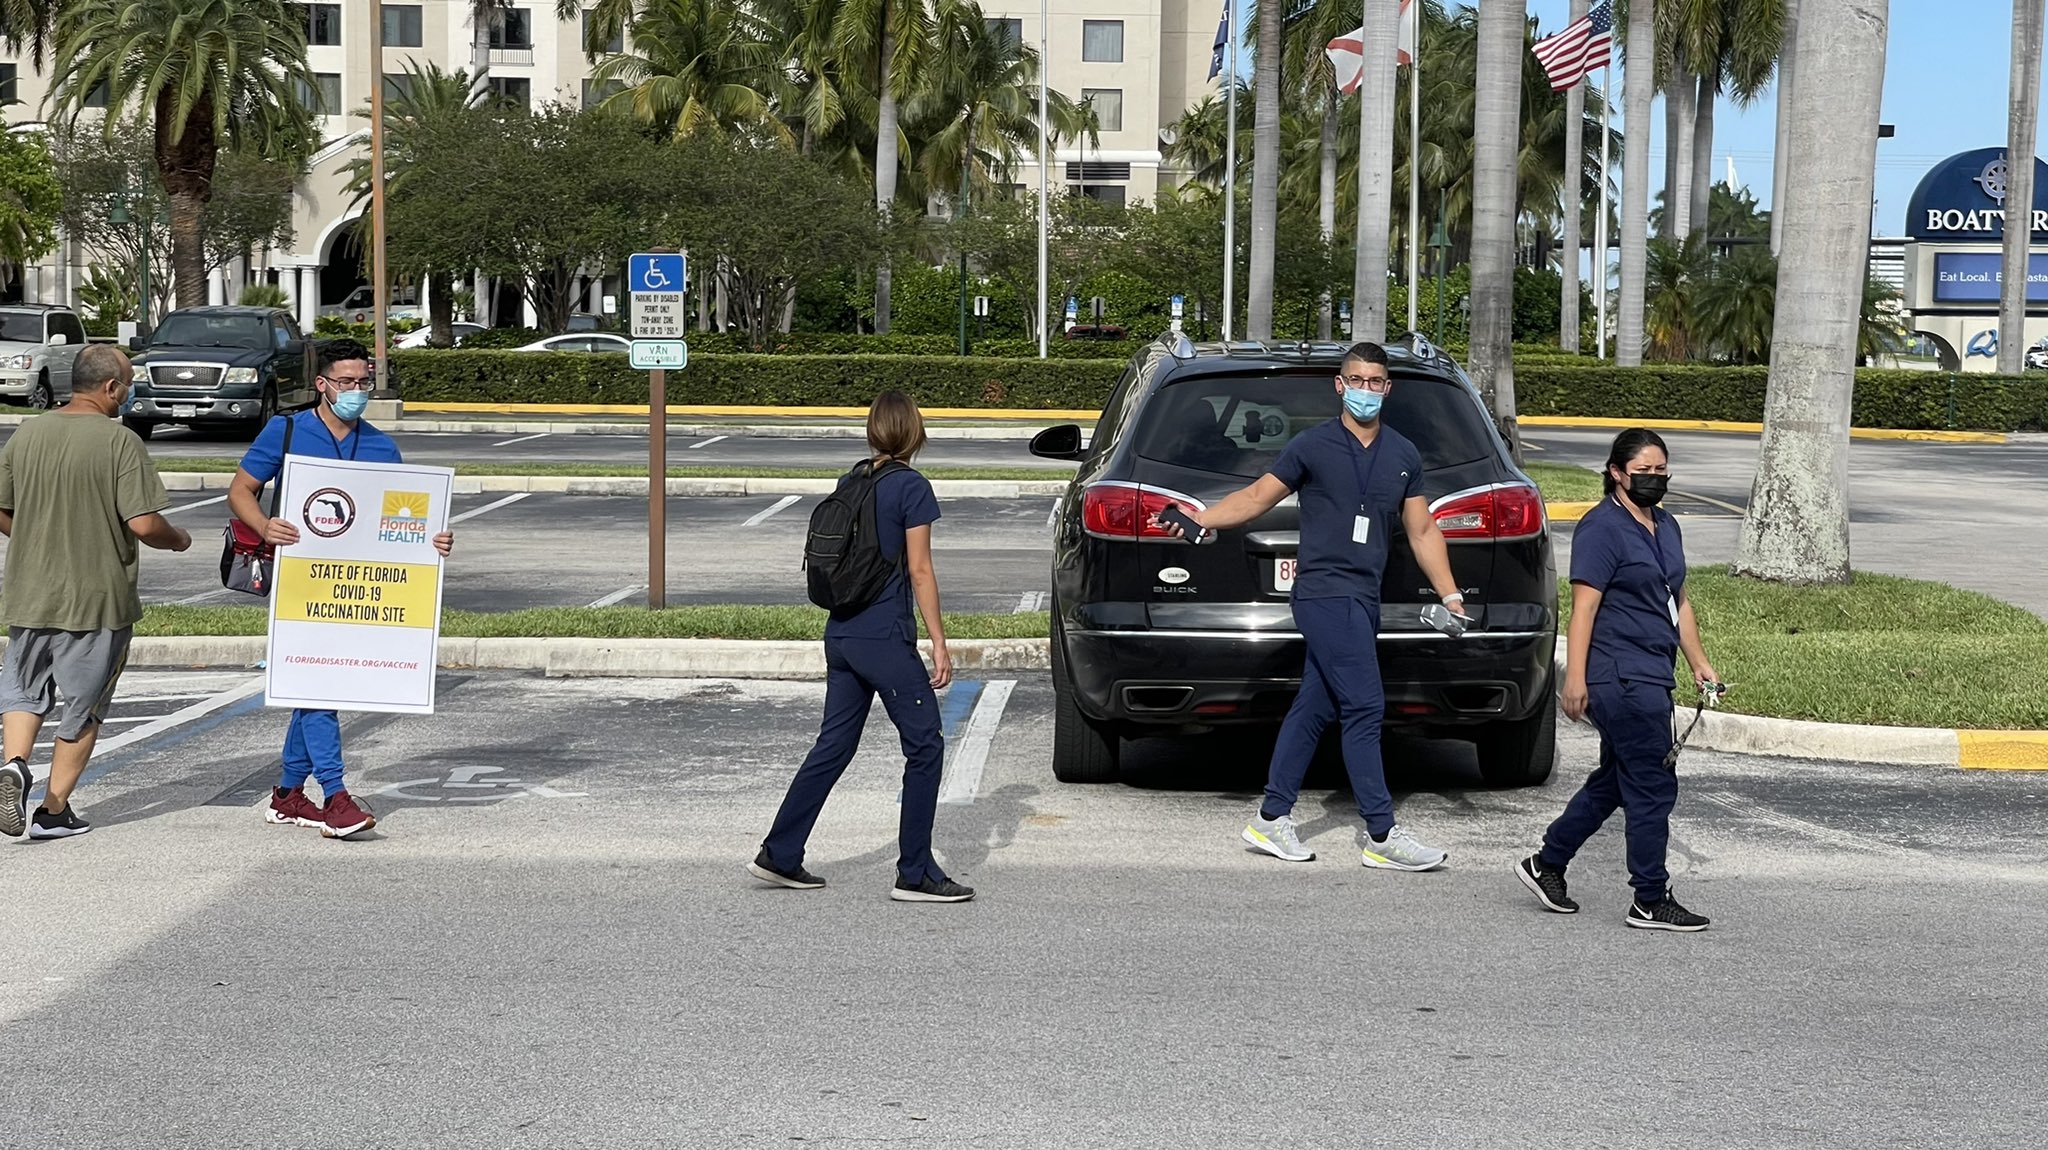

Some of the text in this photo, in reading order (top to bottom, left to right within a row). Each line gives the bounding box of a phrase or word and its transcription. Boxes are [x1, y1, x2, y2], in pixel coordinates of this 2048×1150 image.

[1926, 209, 2048, 231] BOATR
[1940, 272, 1957, 282] Eat
[1960, 271, 1991, 282] Local.
[2027, 273, 2048, 282] asta
[635, 294, 679, 303] PARKING BY DISABLED
[644, 305, 670, 313] PERMIT ONLY
[641, 316, 674, 324] TOW-AWAY ZONE
[640, 327, 648, 335] FINE
[650, 327, 656, 335] UP
[649, 346, 668, 355] VAN
[315, 517, 344, 525] FDEM
[380, 517, 426, 532] Florida
[378, 530, 426, 543] HEALTH
[310, 564, 407, 583] STATE OF FLORIDA
[333, 584, 381, 602] COVID-19
[305, 602, 405, 622] VACCINATION SITE
[285, 655, 419, 670] FLORIDADISASTER.ORG/VACCINE
